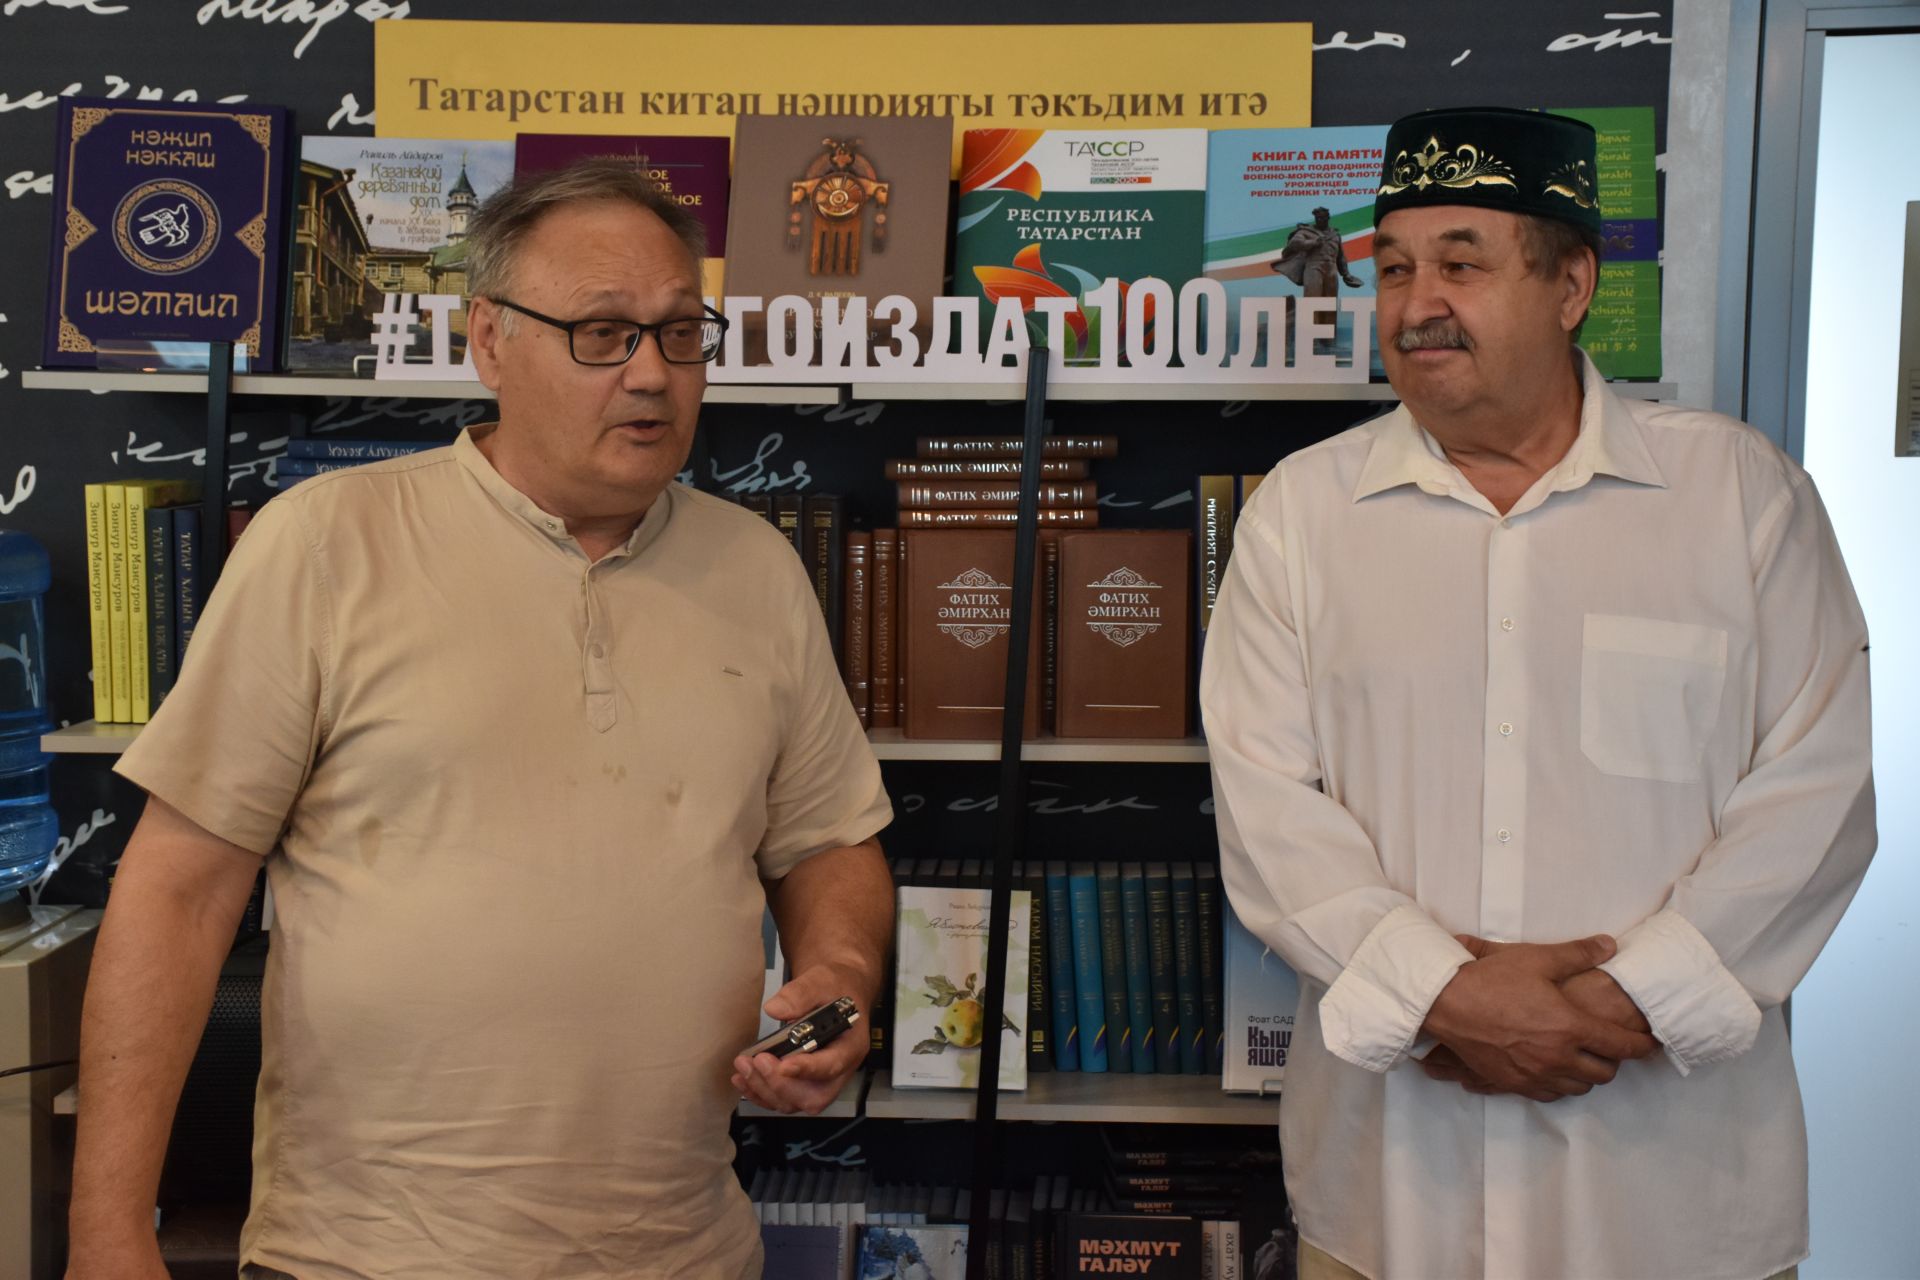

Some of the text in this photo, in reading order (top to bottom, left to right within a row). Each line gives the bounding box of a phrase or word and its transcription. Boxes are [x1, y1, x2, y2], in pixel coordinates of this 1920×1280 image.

[409, 78, 1268, 122] Татарстан китап нәшрияты тәкъдим итә
[131, 130, 212, 147] НӘЖИП
[126, 150, 216, 168] НӘККАШ
[1252, 149, 1383, 161] КНИГА ПАМЯТИ
[371, 163, 442, 182] Казанский
[1243, 171, 1384, 181] ВОЕННО-МОРСКОГО ФЛОТА
[1247, 164, 1305, 172] ПОГИБШИХ
[1284, 180, 1349, 188] УРОЖЕНЦЕВ
[1250, 189, 1320, 197] РЕСПУБЛИКИ
[409, 196, 441, 214] дом
[1007, 208, 1155, 224] РЕСПУБЛИКА
[1017, 226, 1142, 241] ТАТАРСТАН
[953, 441, 994, 450] ФАТИХ
[921, 463, 962, 473] ФАТИХ
[935, 491, 977, 501] ФАТИХ
[90, 502, 101, 548] Зиннур
[110, 503, 121, 549] Зиннур
[129, 503, 140, 550] Зиннур
[152, 527, 164, 565] ТАТАР
[180, 532, 192, 571] ТАТАР
[92, 551, 103, 612] Мансуров
[112, 552, 123, 613] Мансуров
[131, 553, 142, 614] Мансуров
[878, 564, 889, 607] ФАТИХ
[181, 577, 193, 624] ХАЛЫК
[949, 593, 1000, 605] ФАТИХ
[1099, 593, 1150, 604] ФАТИХ
[938, 607, 1011, 619] ӘМИРХАН
[1087, 606, 1161, 618] ӘМИРХАН
[1248, 1015, 1294, 1025] Фоат САД
[1248, 1026, 1293, 1048] Кыш
[1248, 1048, 1289, 1067] яше
[1079, 1239, 1181, 1257] МӘХМҮТ
[1079, 1257, 1152, 1274] ГАЛӘҮ
